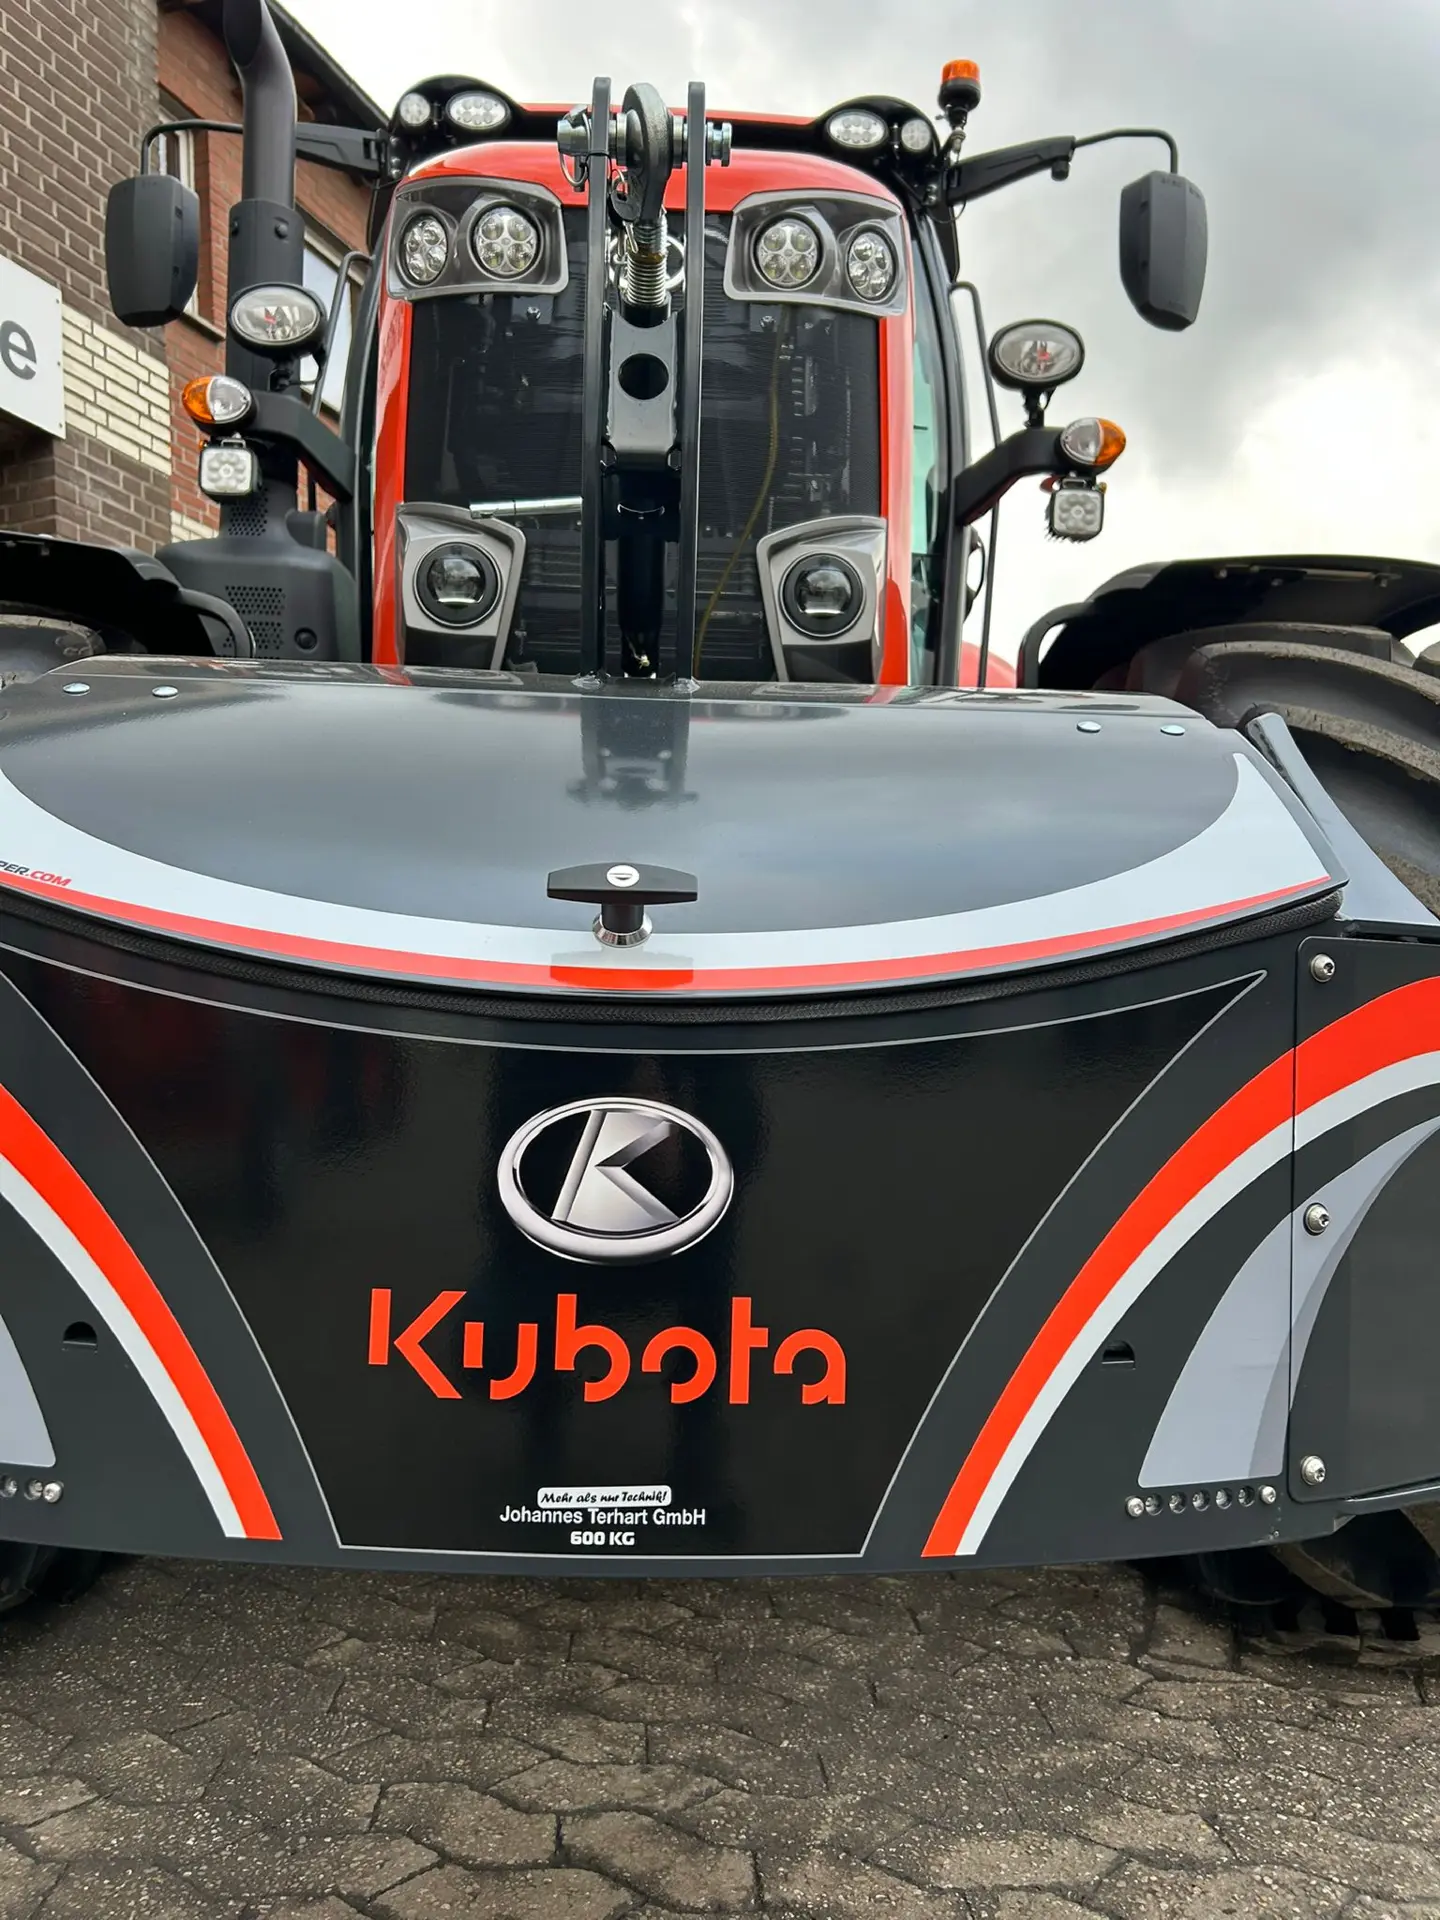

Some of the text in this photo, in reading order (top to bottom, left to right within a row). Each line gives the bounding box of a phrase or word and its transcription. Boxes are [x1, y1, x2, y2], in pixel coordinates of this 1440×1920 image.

[0, 320, 37, 380] e
[551, 1109, 680, 1232] K
[368, 1288, 847, 1405] Kubota
[499, 1505, 706, 1525] Johannes Terhart GmbH
[541, 1490, 668, 1503] Mehr als nur Technik!
[570, 1531, 636, 1546] 600 KG
